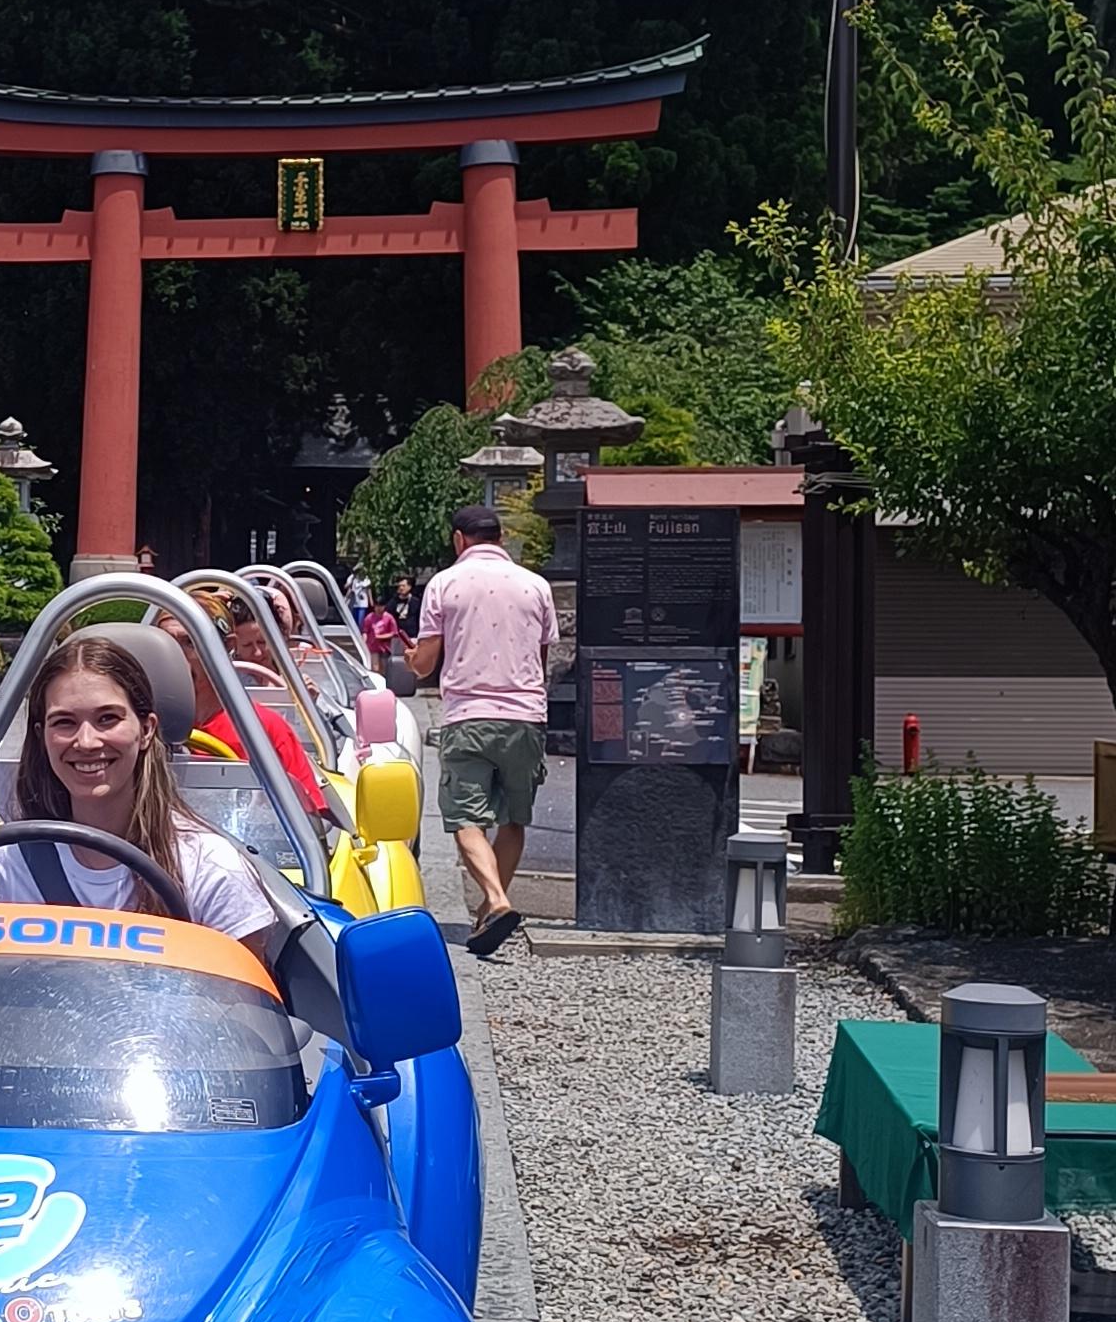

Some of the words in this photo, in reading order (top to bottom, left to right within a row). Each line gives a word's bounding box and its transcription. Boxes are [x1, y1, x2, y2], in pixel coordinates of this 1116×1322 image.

[586, 521, 627, 535] 富士山
[648, 520, 700, 535] Fujisan
